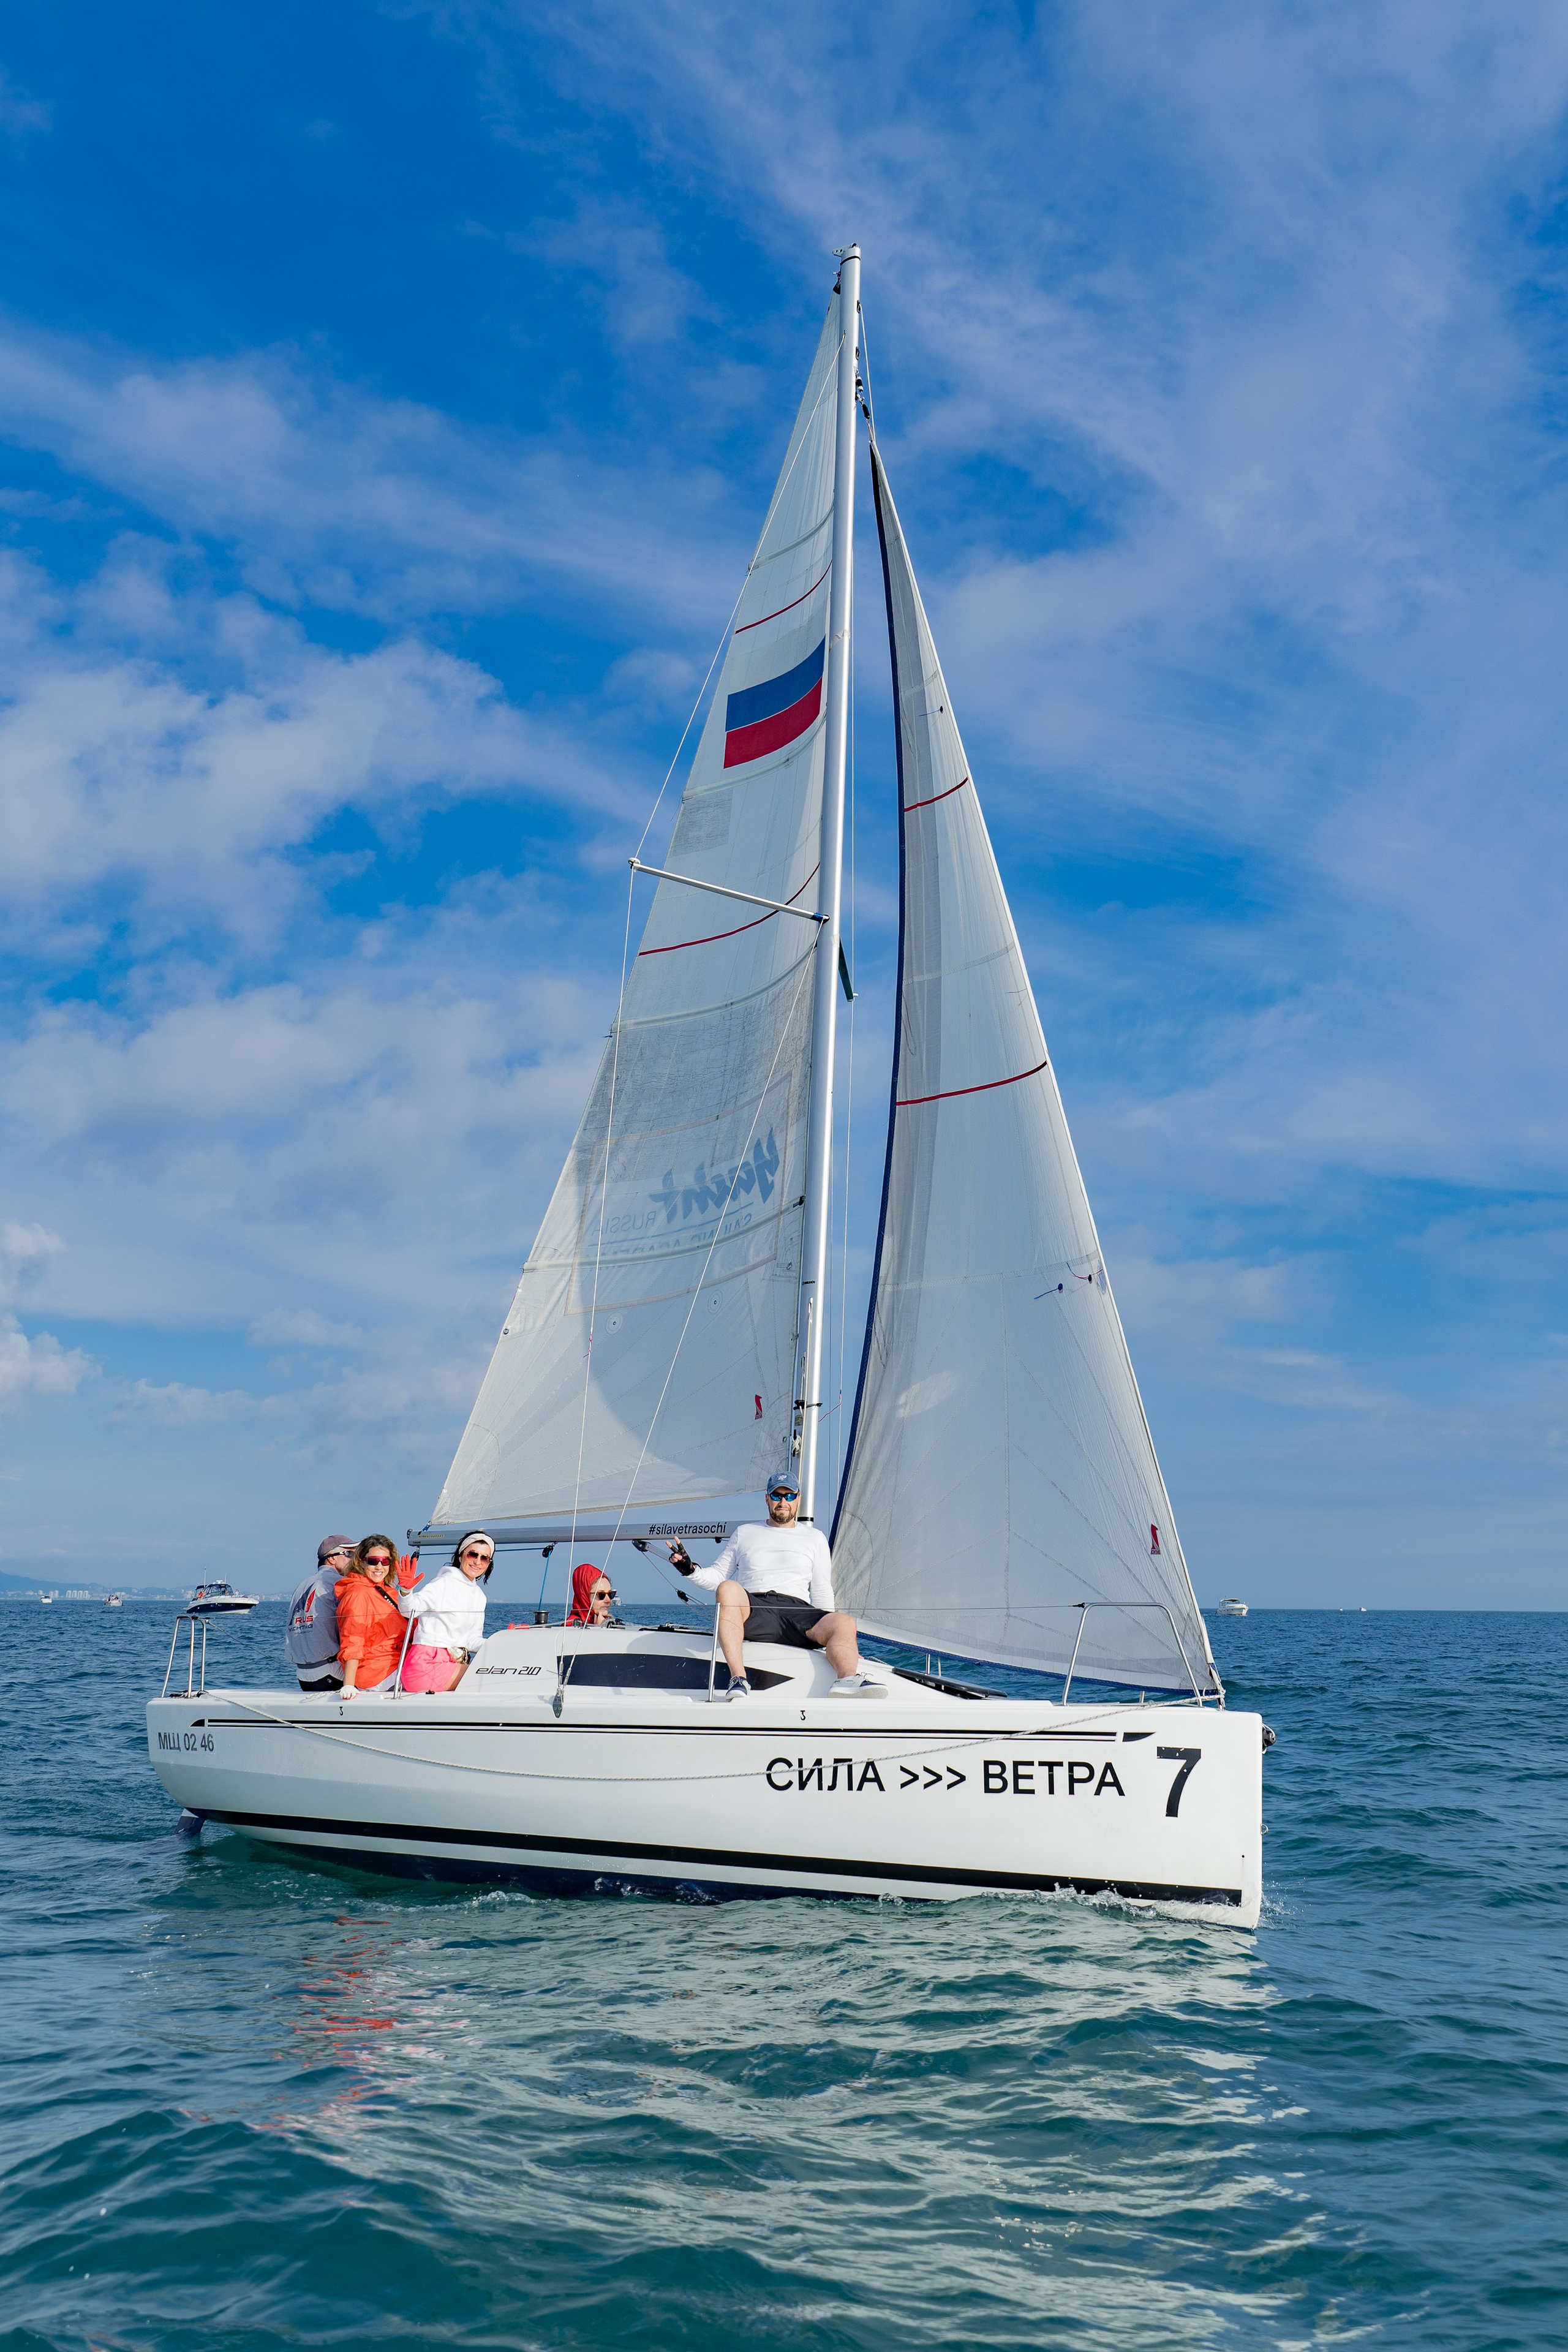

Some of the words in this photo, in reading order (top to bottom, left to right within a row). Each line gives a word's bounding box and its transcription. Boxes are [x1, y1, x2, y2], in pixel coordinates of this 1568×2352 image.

[649, 1521, 727, 1535] #silavetrasochi
[295, 1615, 314, 1624] RUS
[475, 1665, 518, 1675] elan
[518, 1666, 542, 1675] 210
[184, 1733, 197, 1751] 02
[200, 1733, 214, 1752] 46
[766, 1757, 886, 1792] СИЛА
[983, 1760, 1125, 1796] ВЕТРА
[1156, 1746, 1201, 1818] 7
